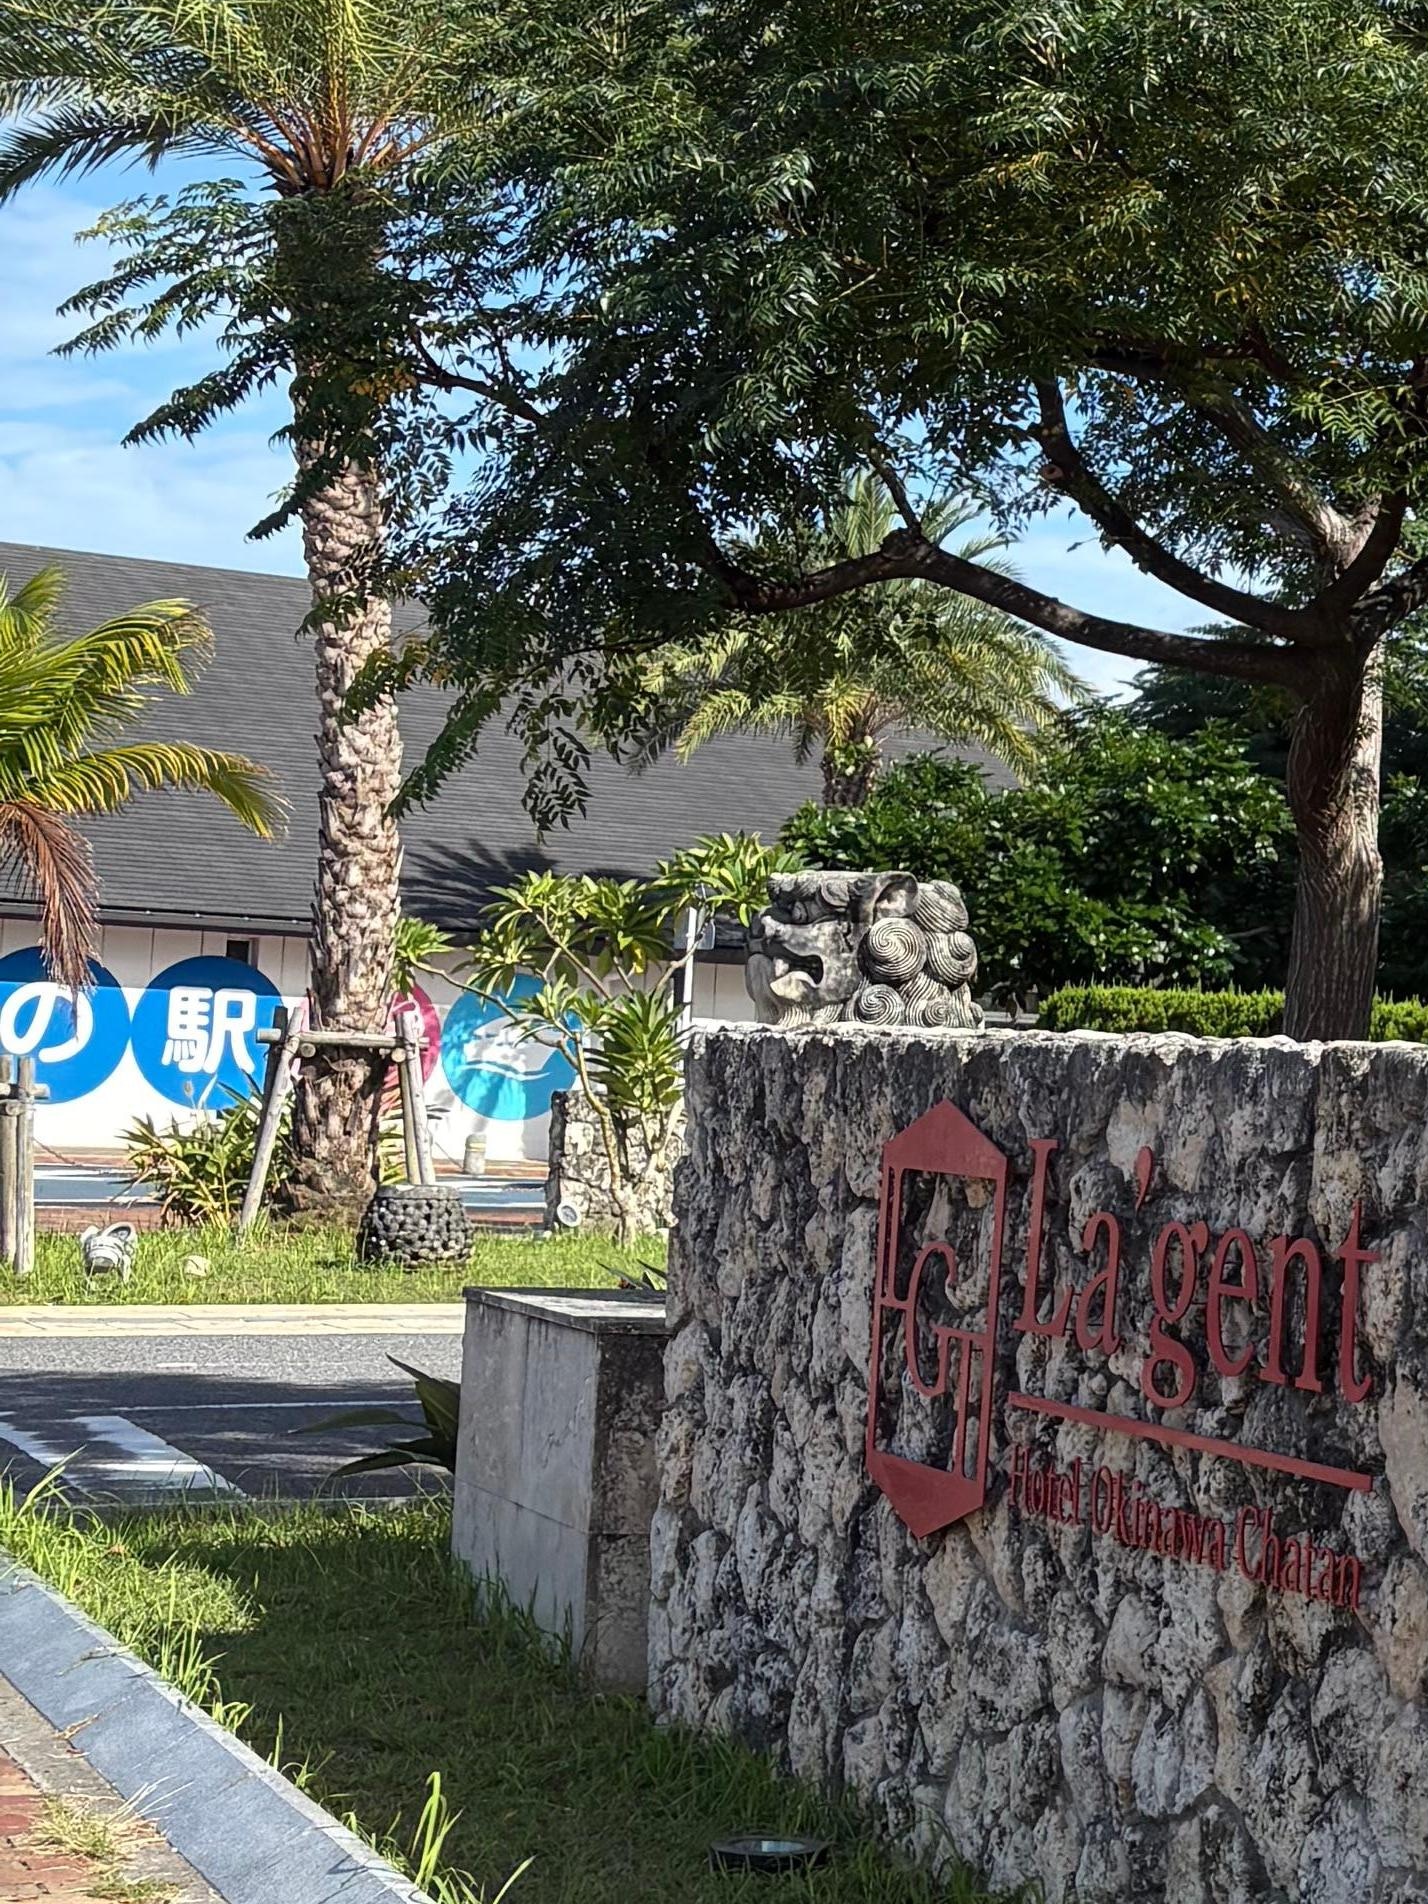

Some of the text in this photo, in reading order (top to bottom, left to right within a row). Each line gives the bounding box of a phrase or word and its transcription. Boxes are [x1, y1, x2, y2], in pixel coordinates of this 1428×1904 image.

[0, 981, 258, 1074] の駅
[1013, 1138, 1379, 1408] La'gent
[1008, 1442, 1366, 1610] Hotel Okinawa Chatan
